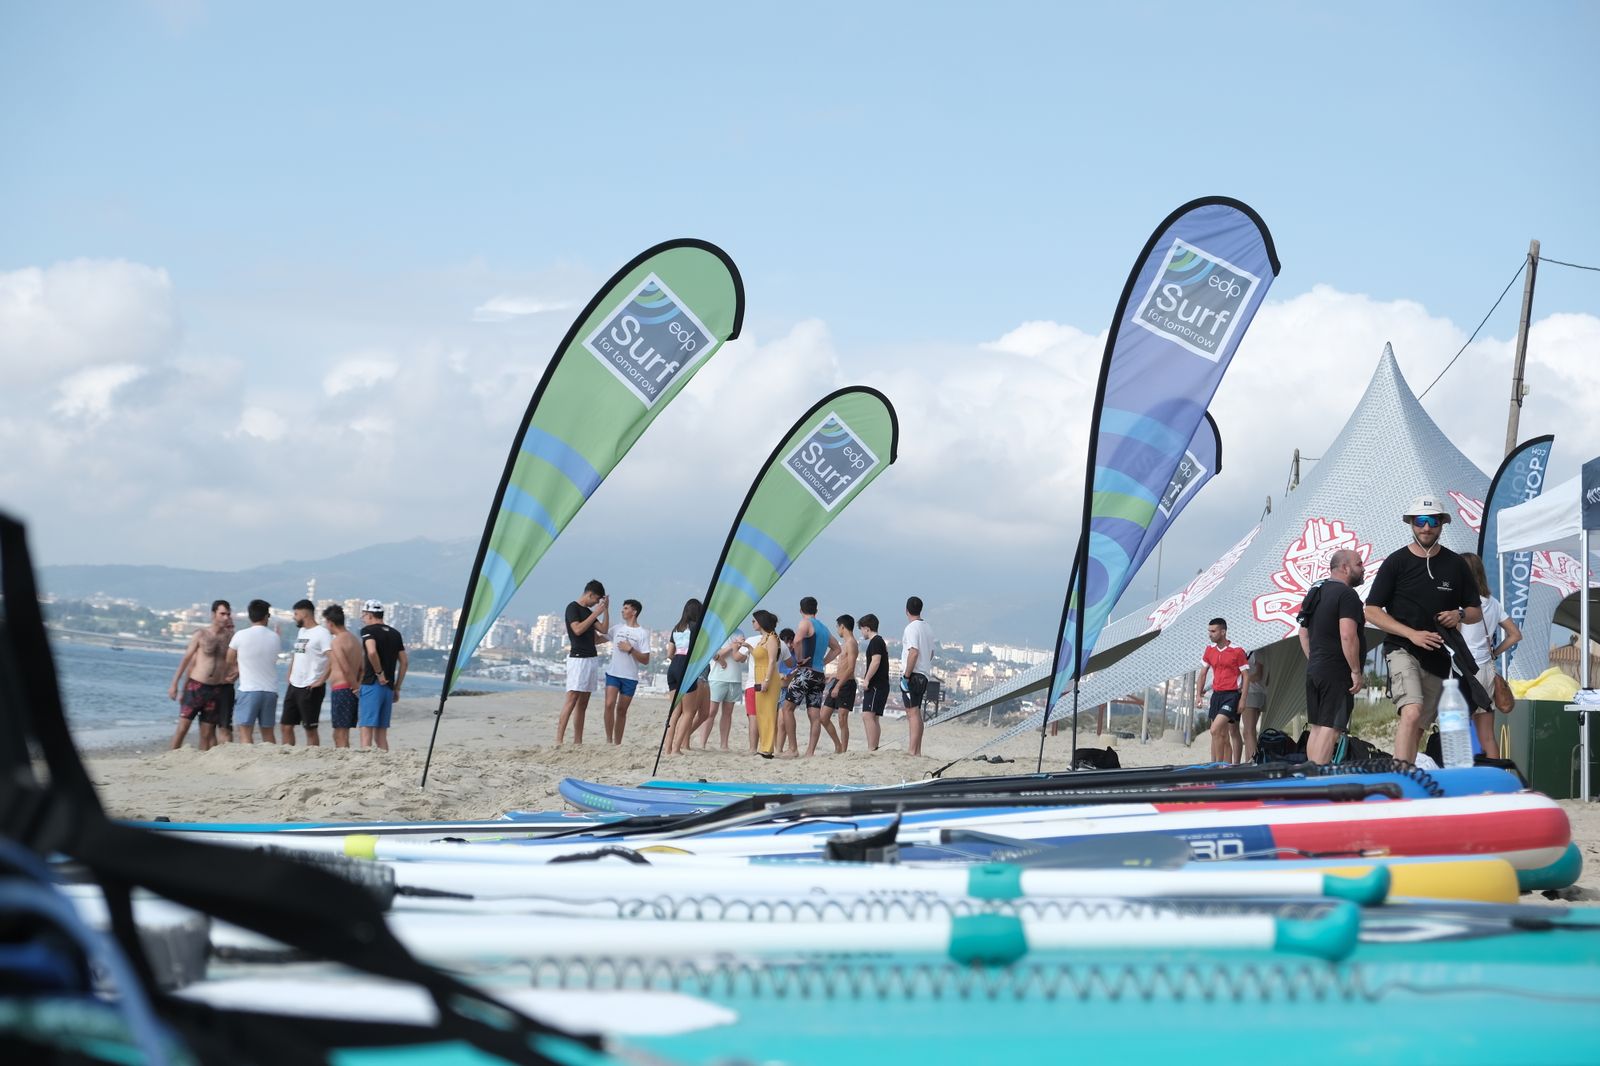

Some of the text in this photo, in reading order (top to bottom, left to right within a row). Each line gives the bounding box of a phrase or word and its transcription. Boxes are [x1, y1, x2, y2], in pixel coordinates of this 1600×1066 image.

[1208, 275, 1241, 299] edp
[1148, 308, 1215, 348] for tomorrow
[1156, 283, 1230, 335] Surf
[611, 315, 680, 383] Surf
[668, 321, 696, 352] edp
[598, 337, 657, 395] for tomorrow
[801, 442, 852, 491] Surf
[843, 446, 865, 469] edp
[1180, 462, 1192, 478] dp
[792, 457, 832, 500] for tomorrow
